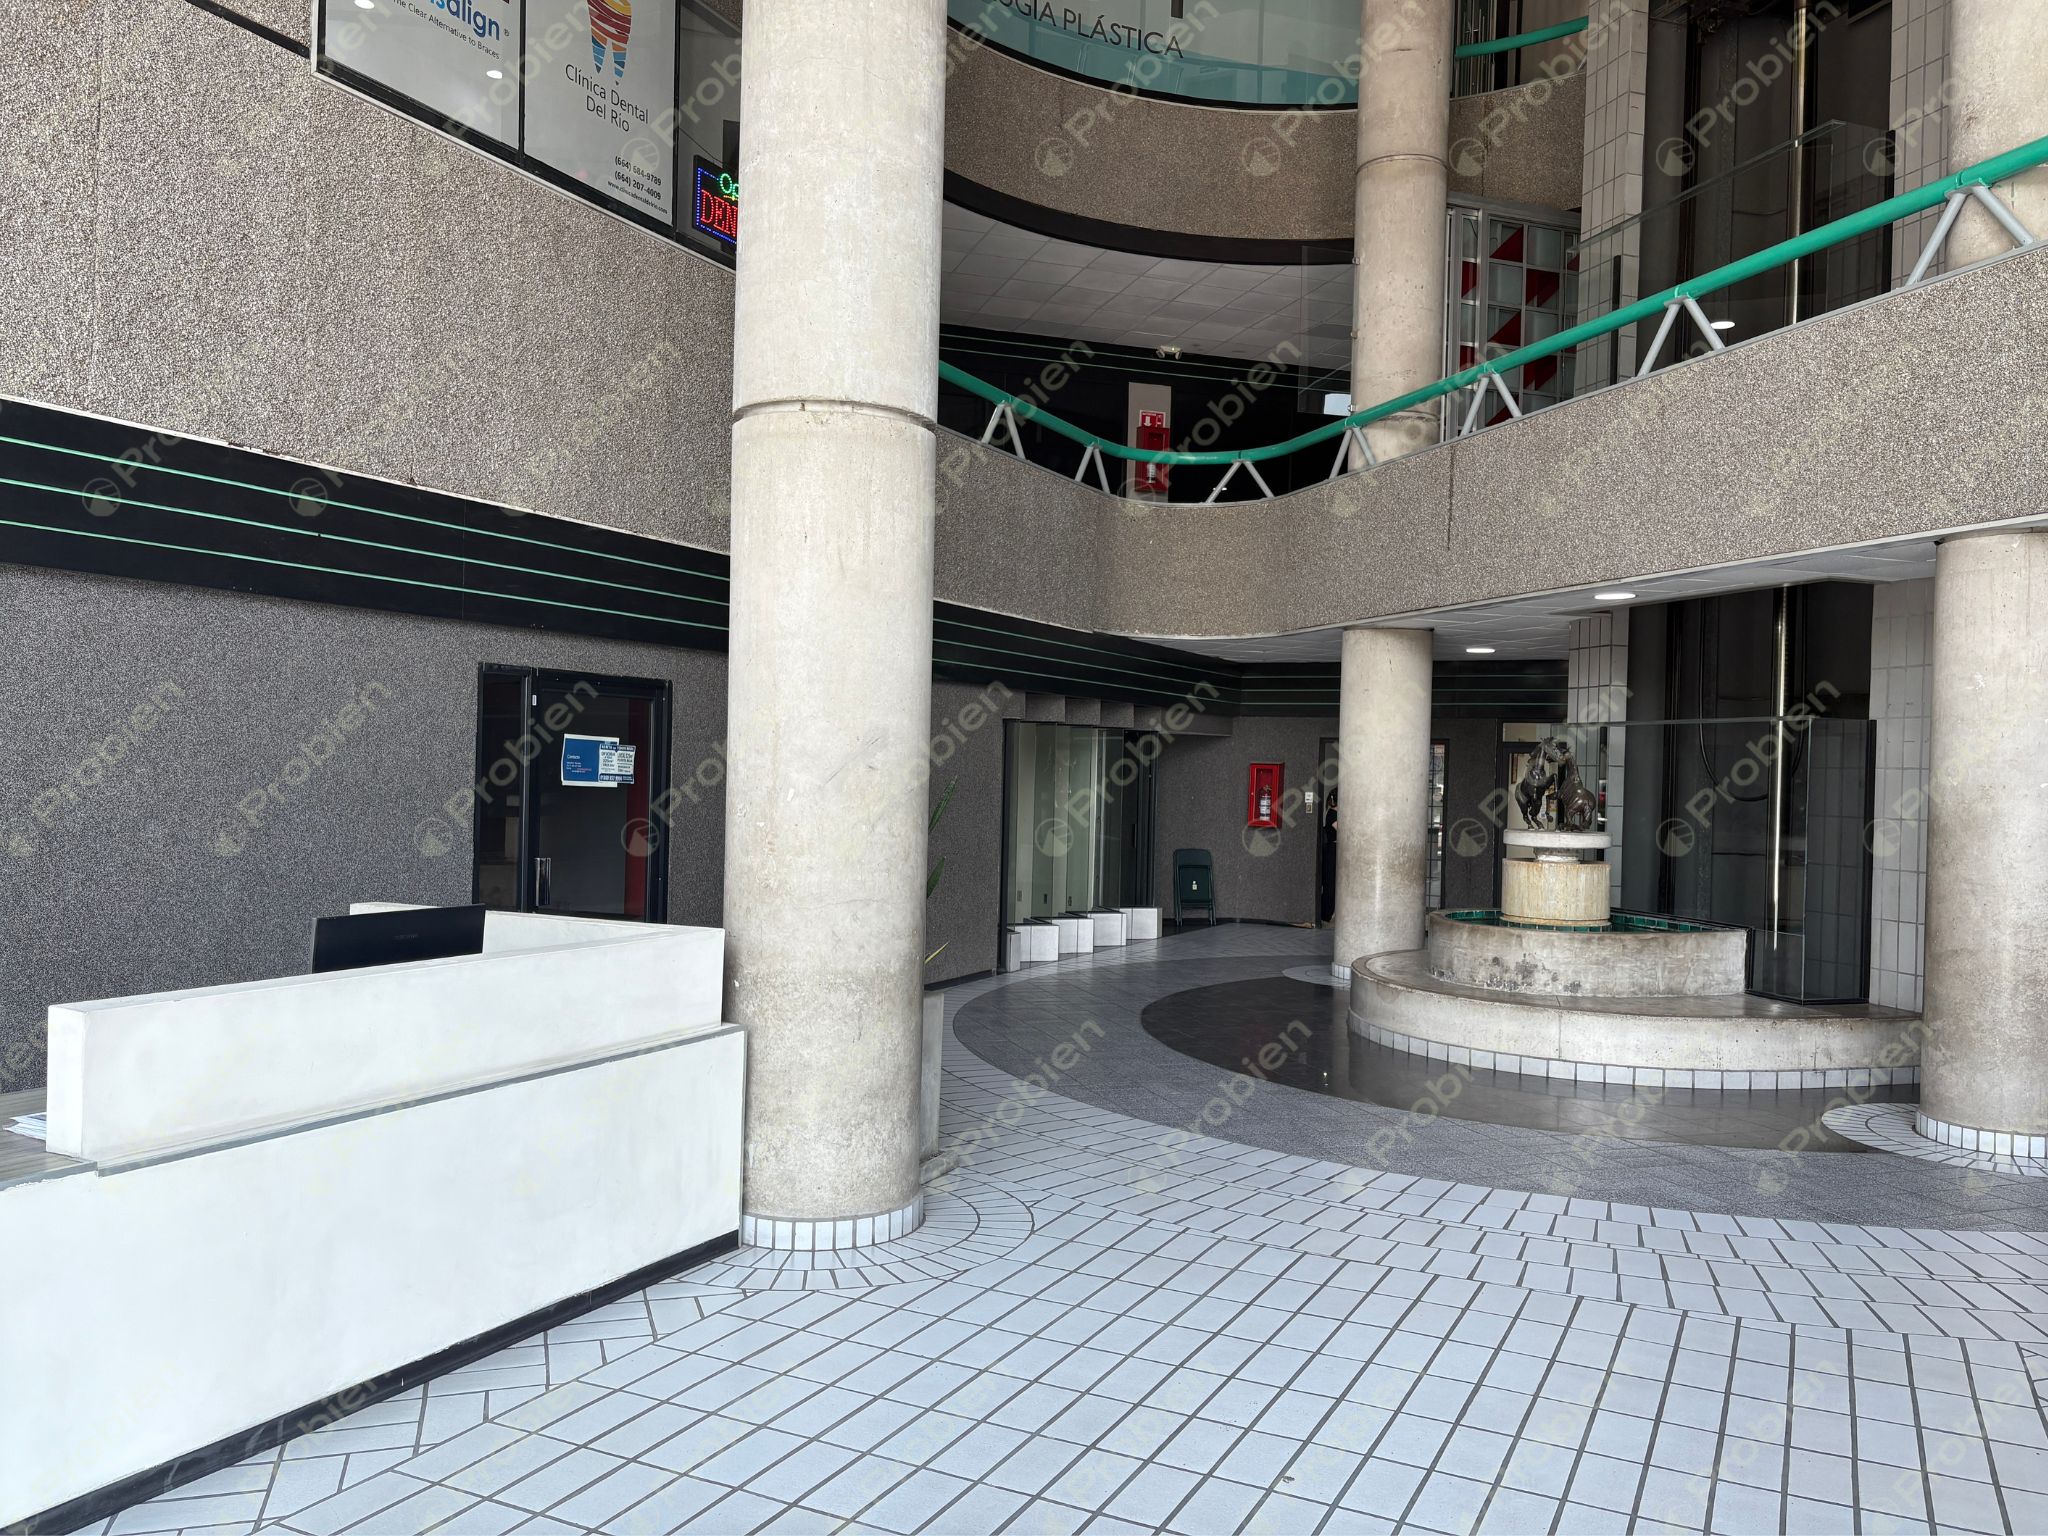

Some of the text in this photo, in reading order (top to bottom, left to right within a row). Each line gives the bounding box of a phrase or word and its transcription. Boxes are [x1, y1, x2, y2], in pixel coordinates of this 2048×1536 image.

[408, 3, 427, 19] Clear
[428, 14, 467, 42] Alternative
[468, 37, 476, 46] to
[477, 41, 500, 60] Braces
[1063, 8, 1184, 59] PLÁSTICA
[565, 64, 649, 124] Clínica Dental
[587, 95, 630, 132] Del Río
[614, 156, 631, 172] (664)
[614, 170, 662, 201] (664) 207-4009
